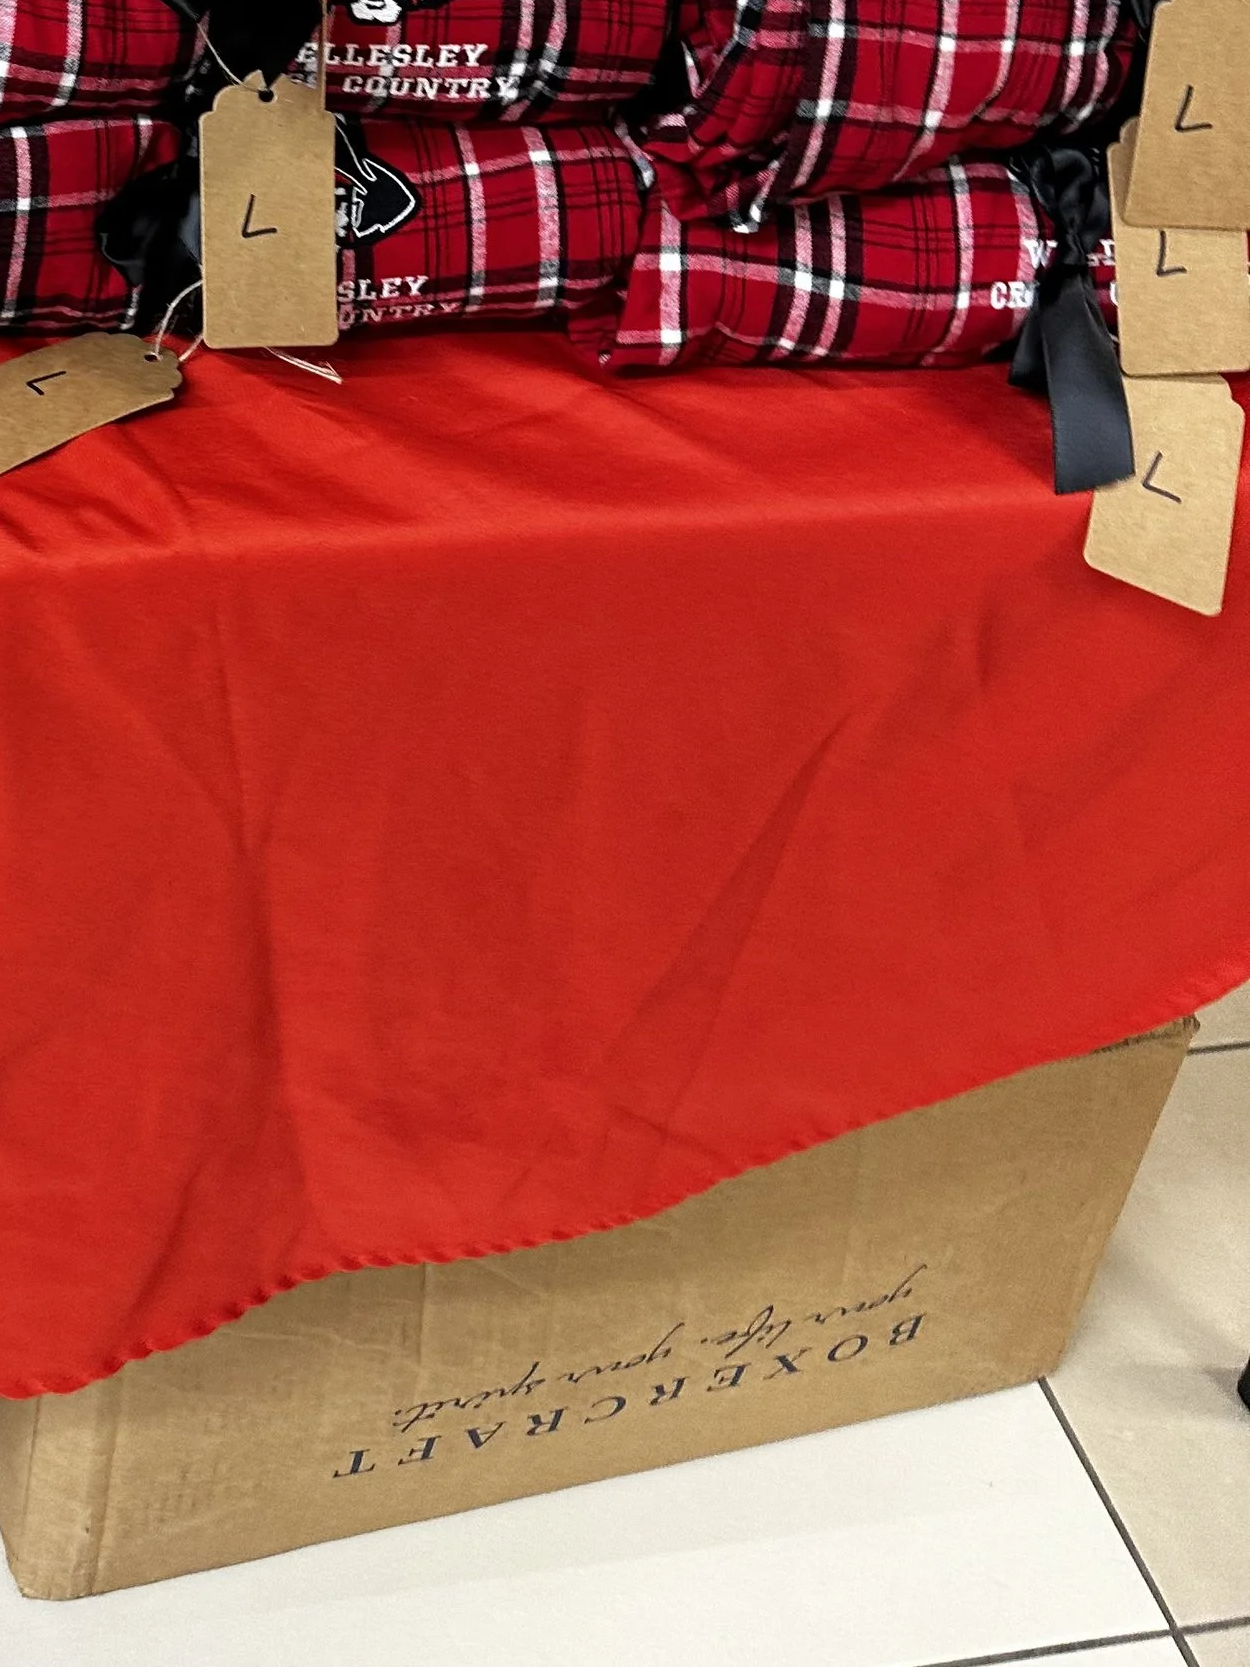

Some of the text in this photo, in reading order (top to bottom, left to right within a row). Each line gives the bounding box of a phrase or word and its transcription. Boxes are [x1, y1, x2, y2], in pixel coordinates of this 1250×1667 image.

[295, 43, 489, 68] ELLESLEY
[342, 74, 519, 105] COUNTRY
[1174, 84, 1213, 132] L
[241, 194, 278, 238] L
[1156, 229, 1188, 277] L
[1141, 449, 1182, 504] L
[804, 1263, 928, 1327] your
[558, 1321, 685, 1384] your
[333, 1311, 927, 1479] BOXERCRAFT
[393, 1360, 547, 1434] spirit.
